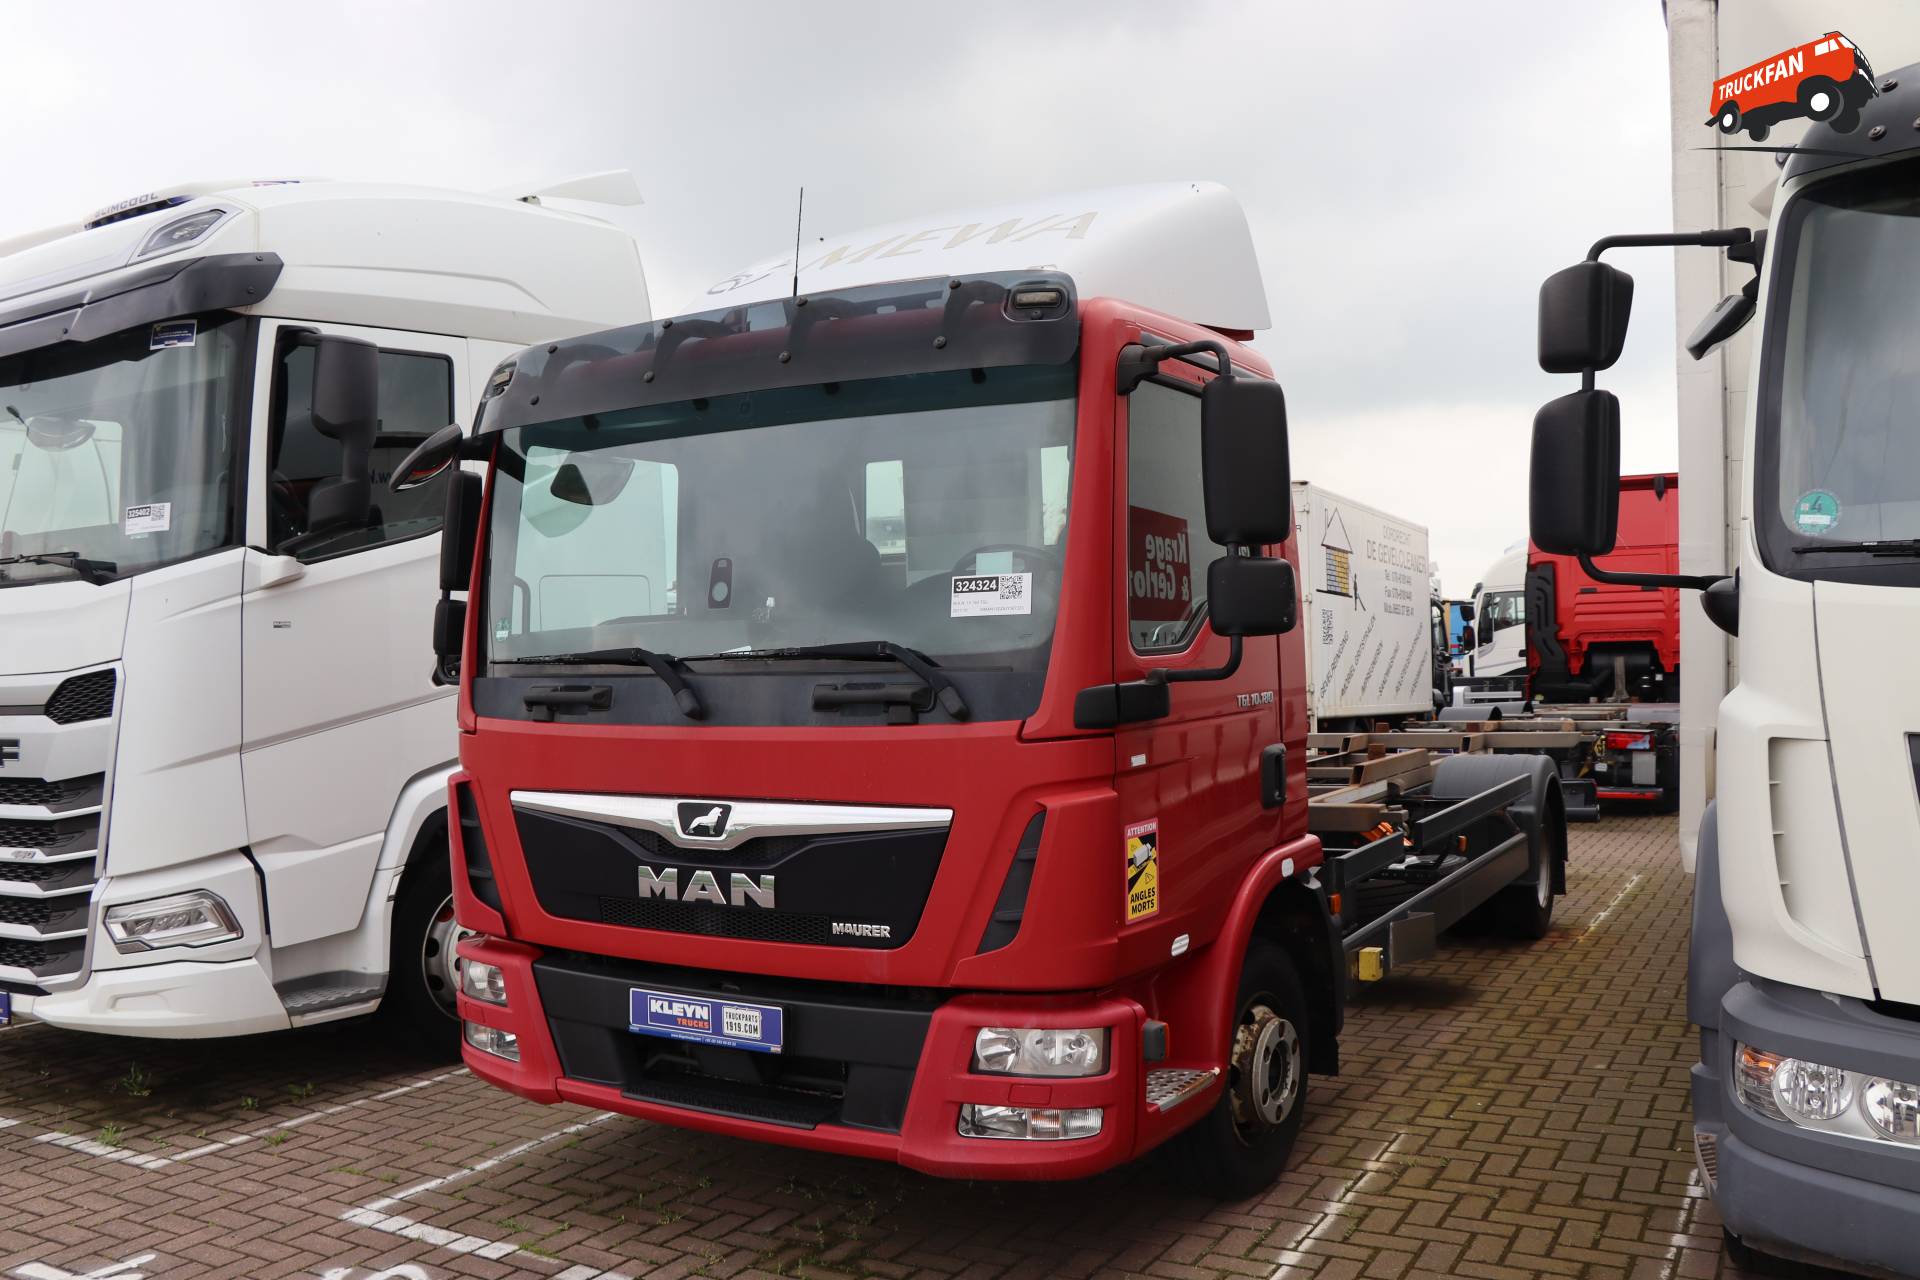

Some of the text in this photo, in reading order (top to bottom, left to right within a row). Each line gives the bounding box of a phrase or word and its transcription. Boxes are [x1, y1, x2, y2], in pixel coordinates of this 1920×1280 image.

[796, 211, 1098, 272] MEWA
[955, 579, 997, 592] 324324
[1236, 693, 1250, 707] TGL
[1127, 822, 1157, 837] ATTENTION
[638, 865, 775, 909] MAN
[1130, 887, 1156, 904] ANGLES
[1131, 898, 1155, 915] MORTS
[832, 921, 891, 938] MAURER
[650, 999, 709, 1020] KLEYN
[725, 1011, 758, 1024] TRUCKPARTS
[677, 1017, 709, 1029] TRUCKS
[725, 1021, 759, 1035] 1919.COM
